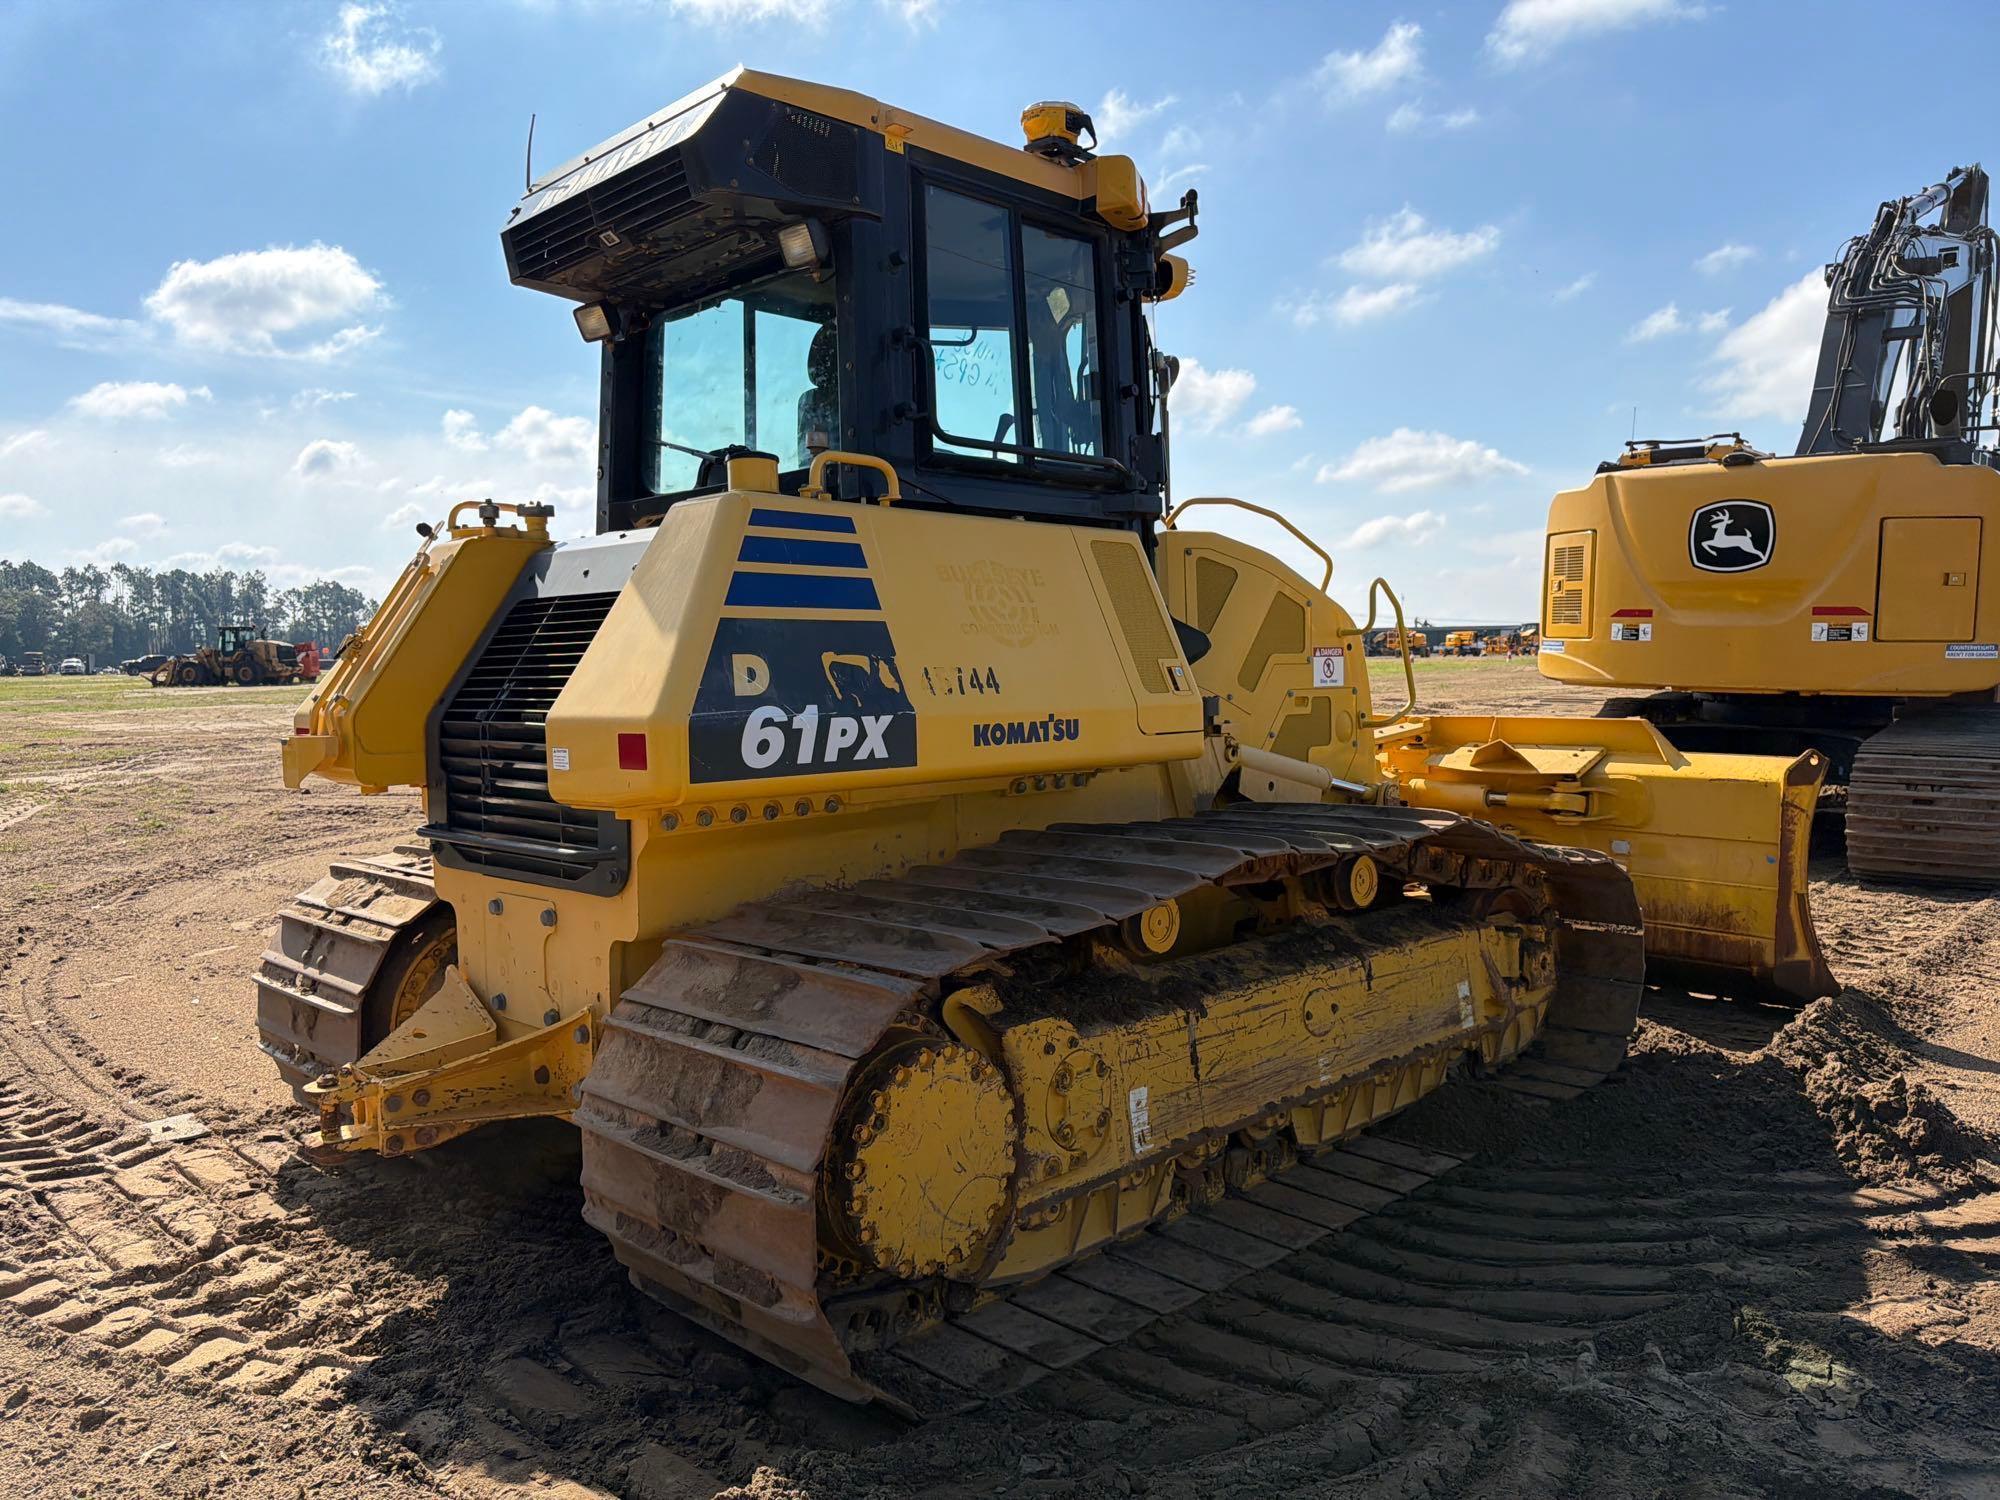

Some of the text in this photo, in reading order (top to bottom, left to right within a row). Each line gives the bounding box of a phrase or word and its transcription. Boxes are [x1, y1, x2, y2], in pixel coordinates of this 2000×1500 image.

[1320, 648, 1342, 656] DANGER
[732, 653, 770, 697] D
[741, 704, 894, 769] 61PX
[973, 714, 1079, 747] KOMATSU
